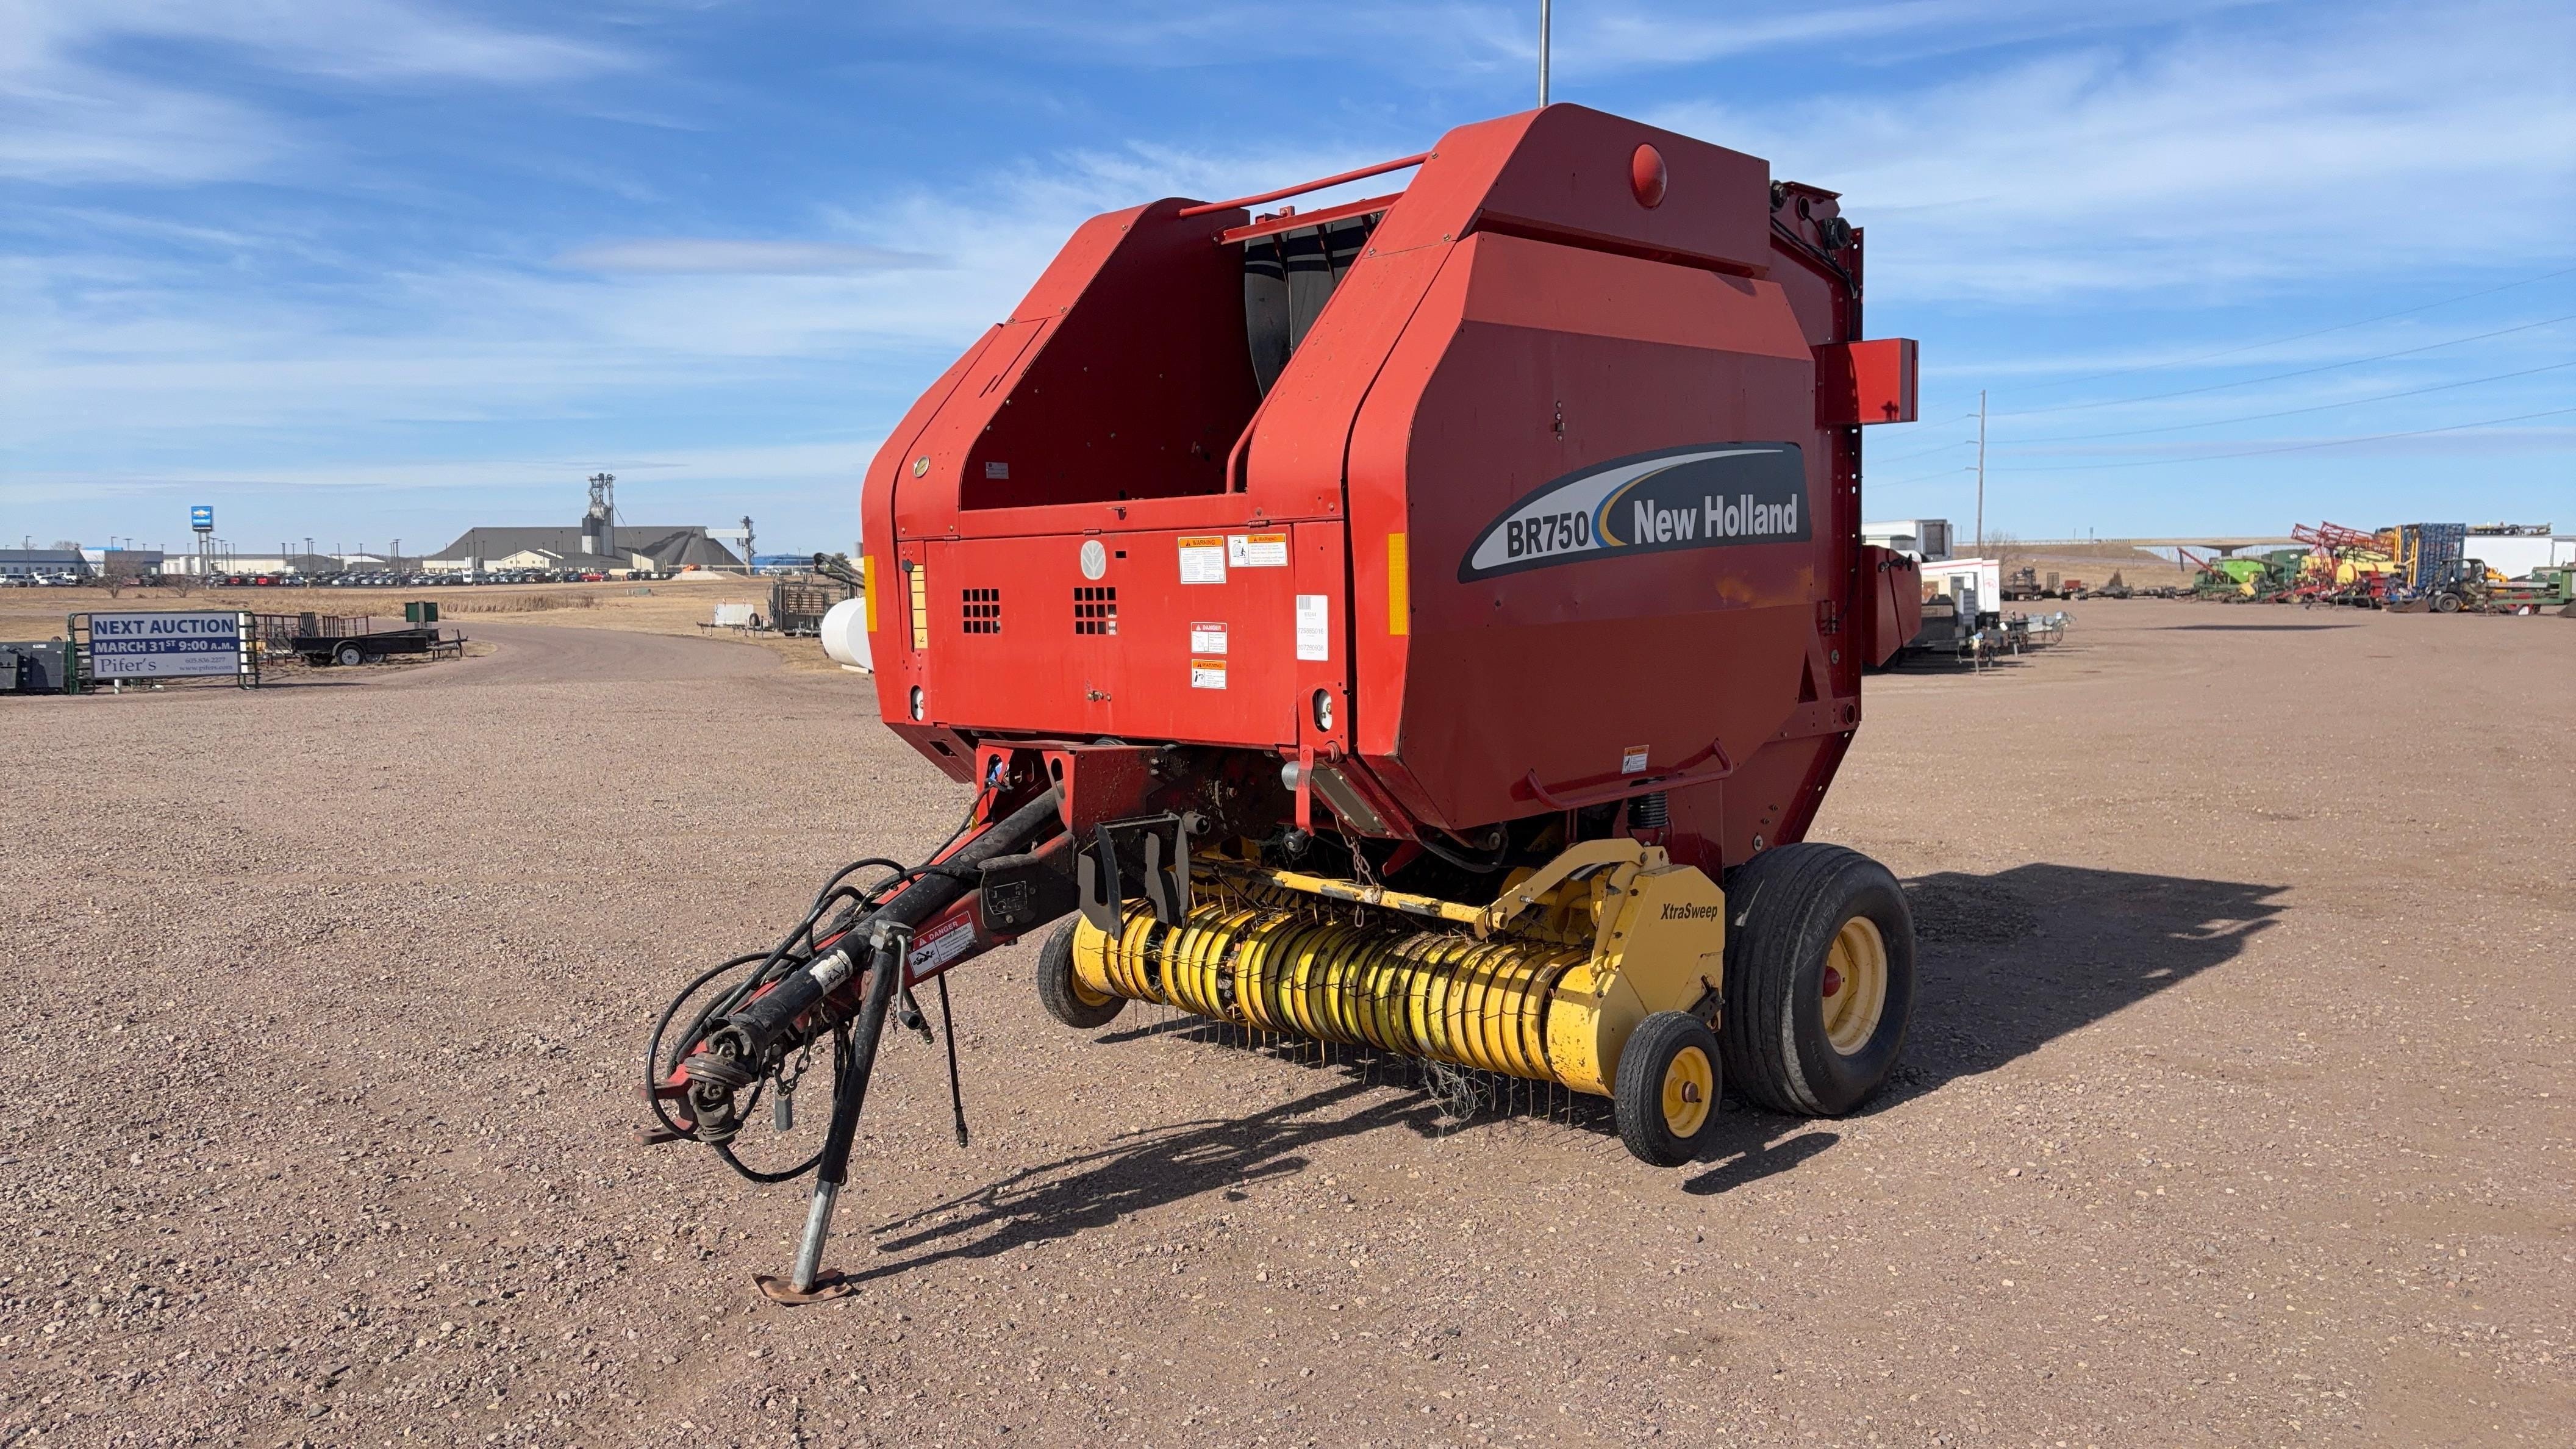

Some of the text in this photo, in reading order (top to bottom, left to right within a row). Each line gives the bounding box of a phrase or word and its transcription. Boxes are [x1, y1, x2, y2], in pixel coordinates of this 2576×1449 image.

[1634, 493, 1797, 545] New Holland
[1506, 510, 1588, 559] BR750
[94, 619, 234, 635] NEXT AUCTION
[95, 641, 146, 653] MARCH
[178, 640, 207, 651] 9:00
[99, 657, 157, 673] Pifer's
[1661, 902, 1718, 922] XtraSweep
[928, 921, 959, 940] DANGER
